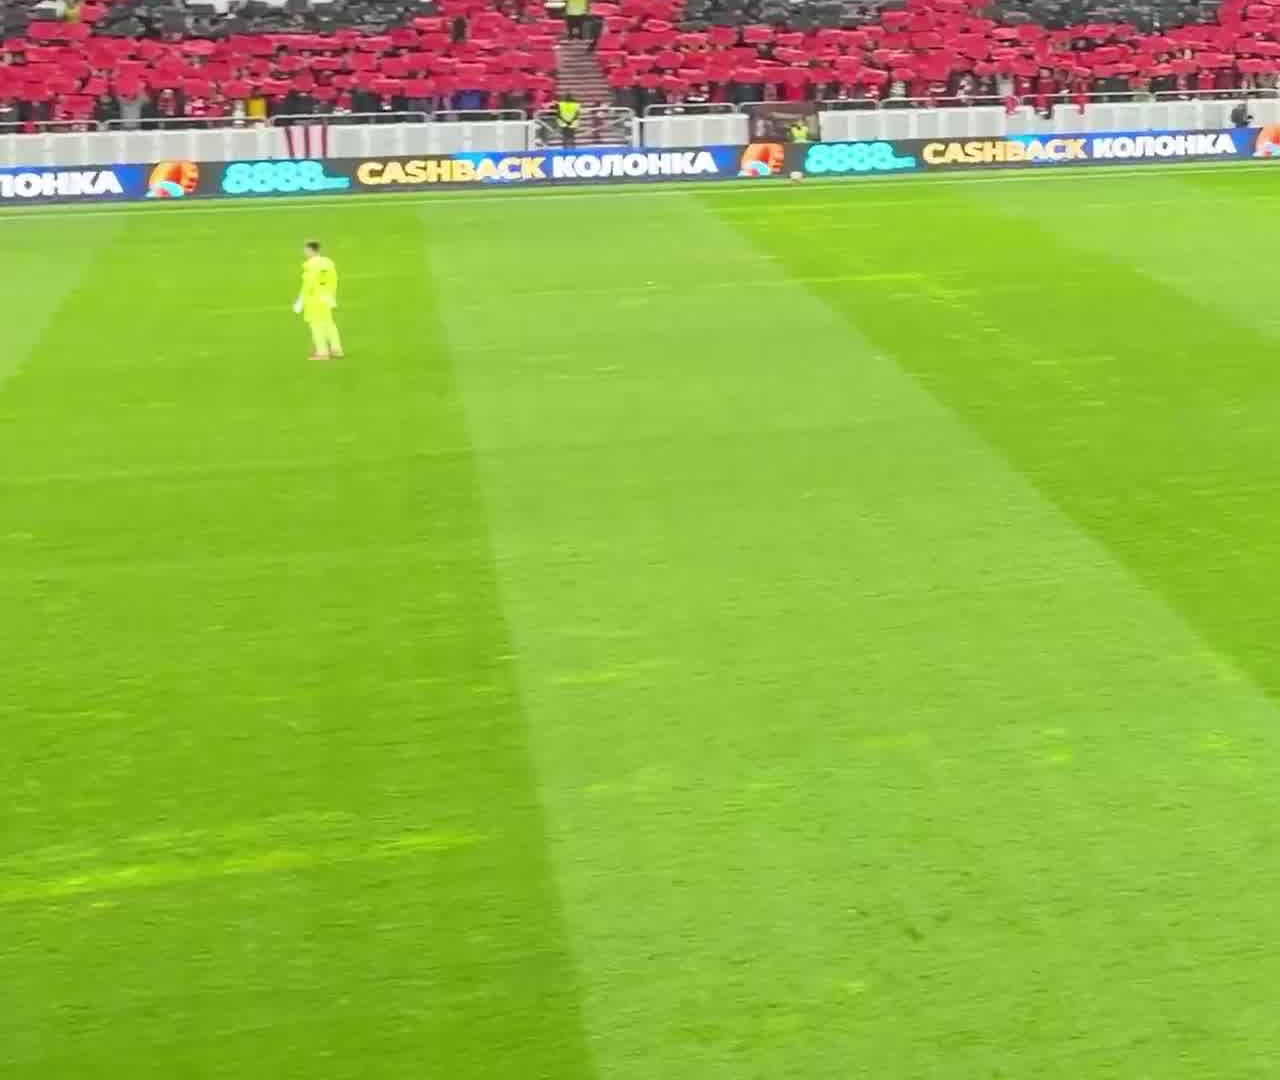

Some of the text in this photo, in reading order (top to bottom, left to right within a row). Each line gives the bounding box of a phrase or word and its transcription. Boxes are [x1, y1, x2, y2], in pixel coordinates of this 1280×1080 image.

[921, 133, 1238, 165] CASHBACK КОЛОНКА
[357, 150, 720, 186] CASHBACK КОЛОНКА
